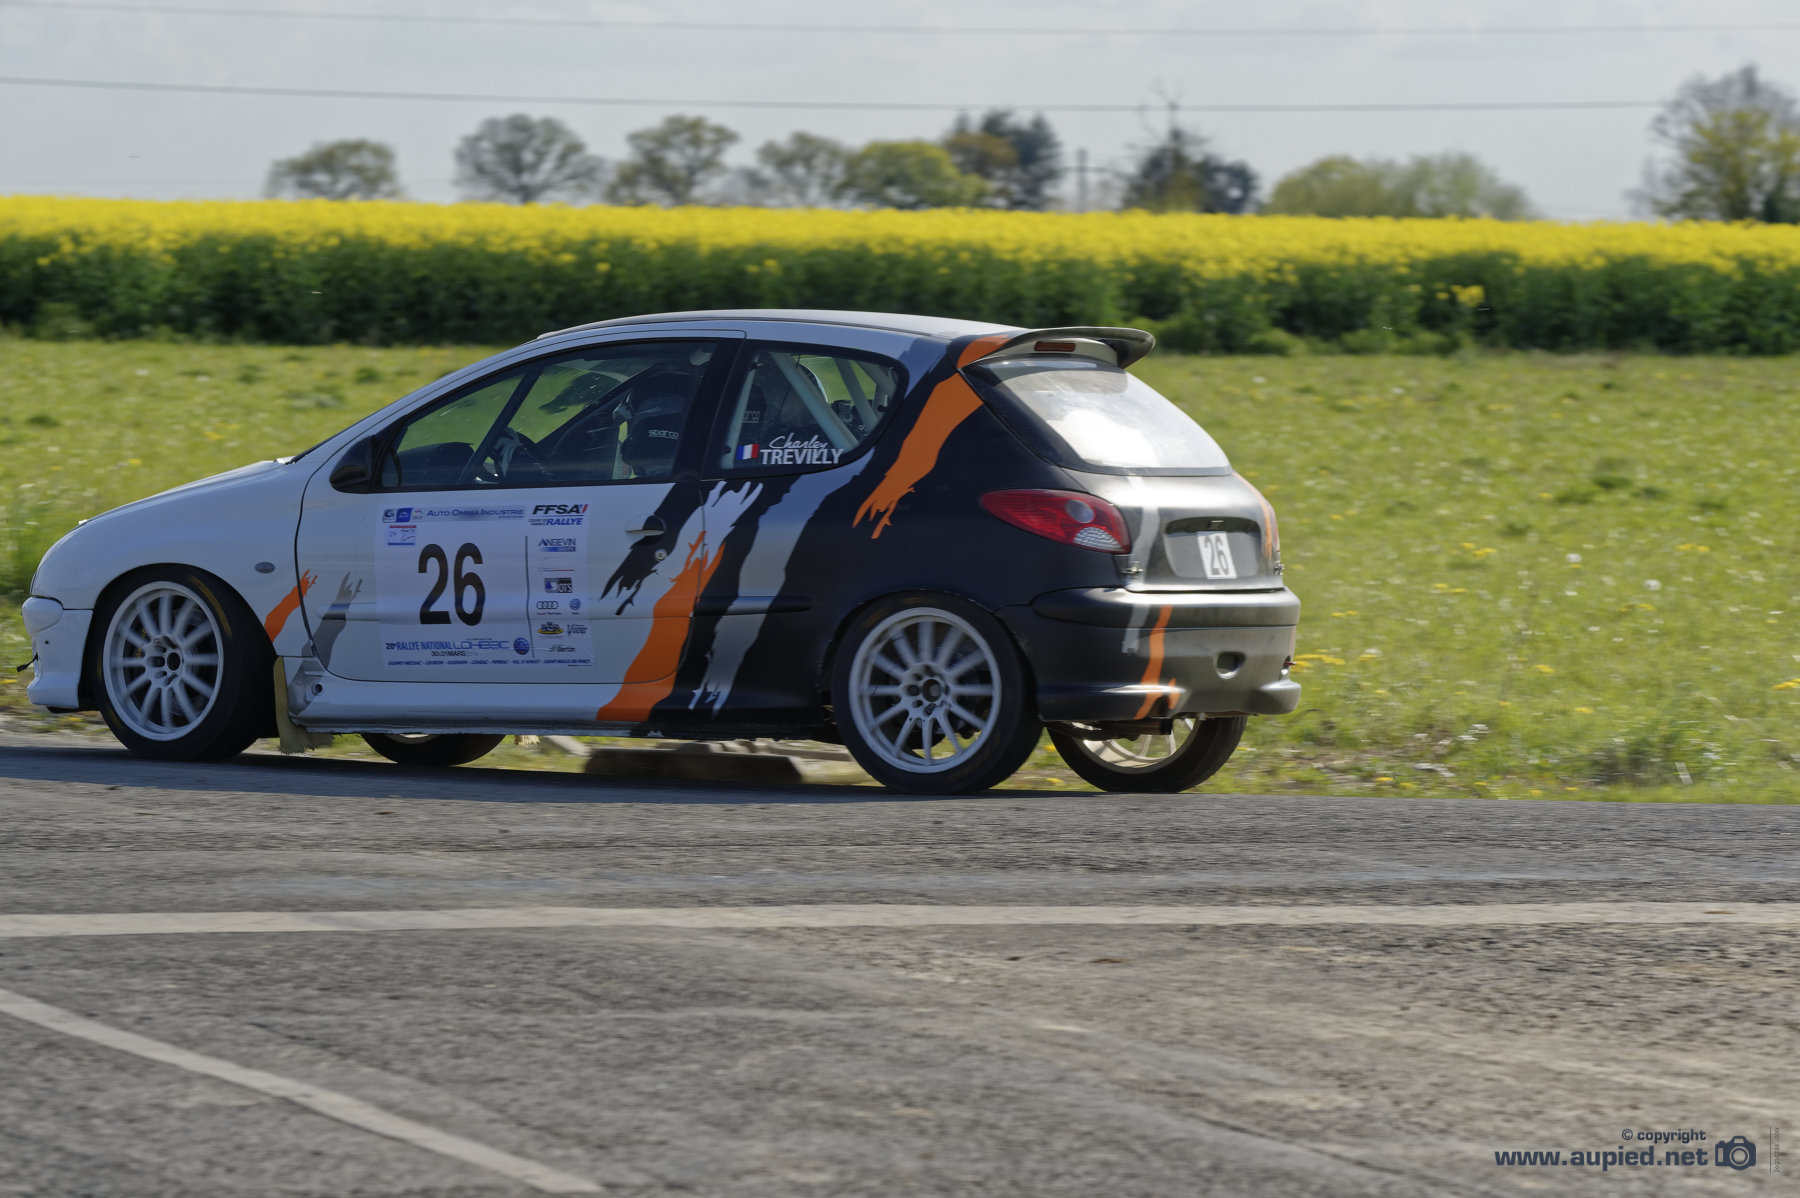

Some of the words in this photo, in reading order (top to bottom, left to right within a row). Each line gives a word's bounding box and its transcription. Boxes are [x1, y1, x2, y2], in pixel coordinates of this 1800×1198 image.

[532, 504, 581, 515] FFSA
[546, 518, 584, 526] RALLYE
[1204, 535, 1229, 576] 26
[418, 542, 486, 627] 26
[421, 641, 453, 650] NATIONAL
